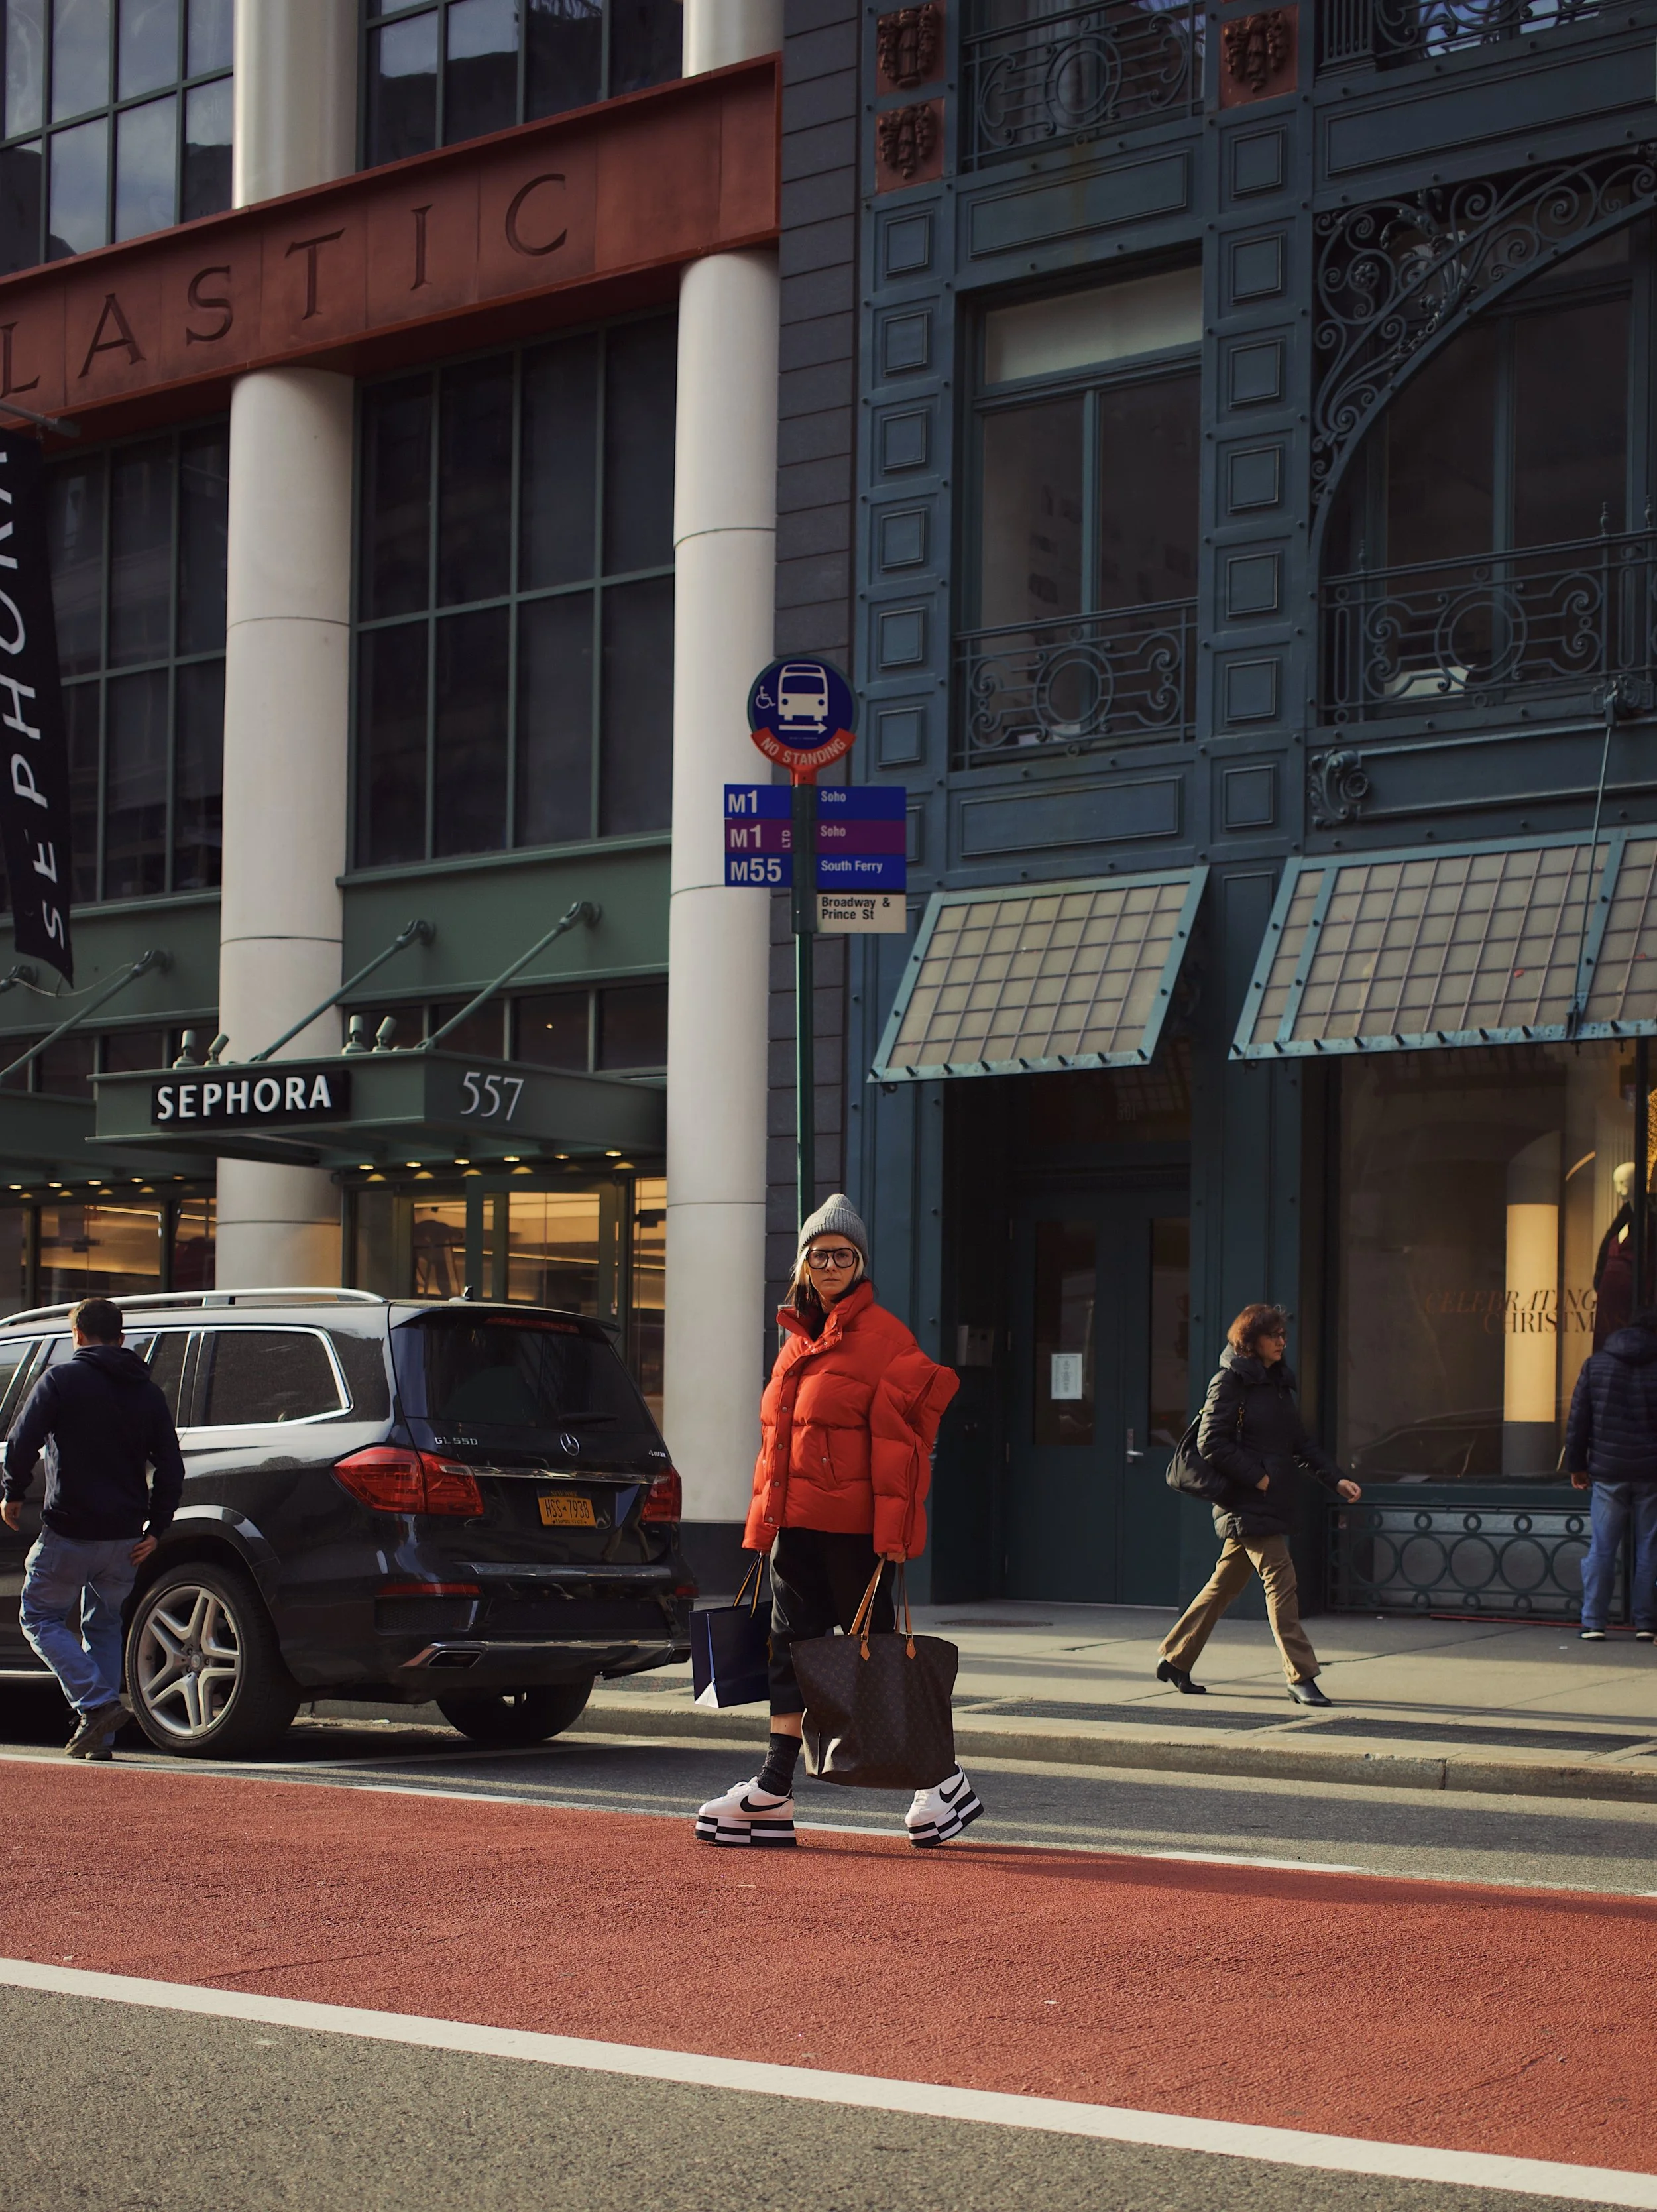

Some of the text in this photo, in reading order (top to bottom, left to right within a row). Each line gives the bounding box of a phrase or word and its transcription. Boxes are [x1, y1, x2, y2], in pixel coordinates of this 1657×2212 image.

[0, 451, 65, 950] SEPHO
[760, 737, 846, 765] NO STANDING
[728, 789, 758, 813] M1
[821, 791, 846, 802] Soho
[730, 824, 762, 848] M1
[781, 829, 791, 848] LTD
[820, 825, 846, 837] Soho
[730, 858, 782, 882] M55
[821, 860, 883, 874] South Ferry
[821, 897, 890, 909] Broadway &
[821, 909, 874, 919] Prince St
[156, 1074, 331, 1120] SEPHORA
[459, 1071, 524, 1121] 557
[434, 1436, 451, 1445] GL
